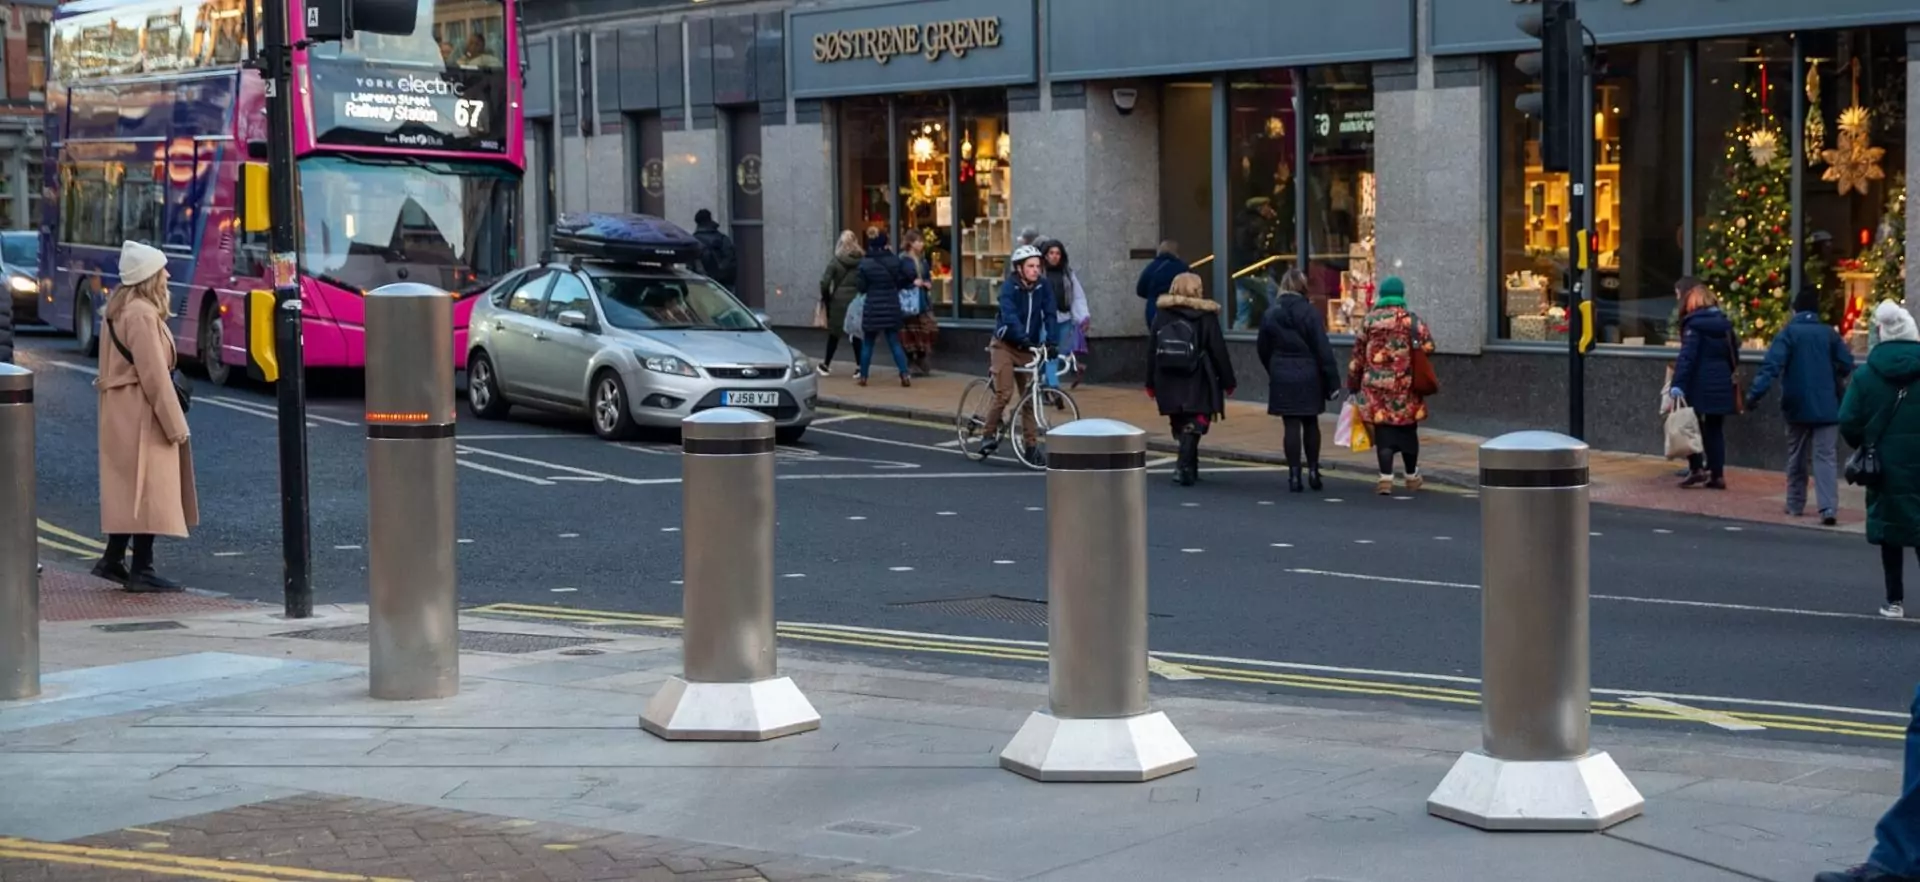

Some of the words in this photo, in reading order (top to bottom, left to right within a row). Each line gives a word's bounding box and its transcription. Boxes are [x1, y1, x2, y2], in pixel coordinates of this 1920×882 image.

[813, 24, 920, 65] SØSTRENE
[924, 16, 1001, 61] GRENE
[356, 78, 394, 89] YORK
[398, 74, 465, 96] electric
[351, 92, 396, 105] Lawrence
[398, 94, 431, 107] Street
[345, 101, 393, 122] Railway
[395, 105, 438, 122] Station
[454, 99, 484, 127] 67
[729, 392, 755, 404] YJ58
[757, 392, 776, 404] YJT
